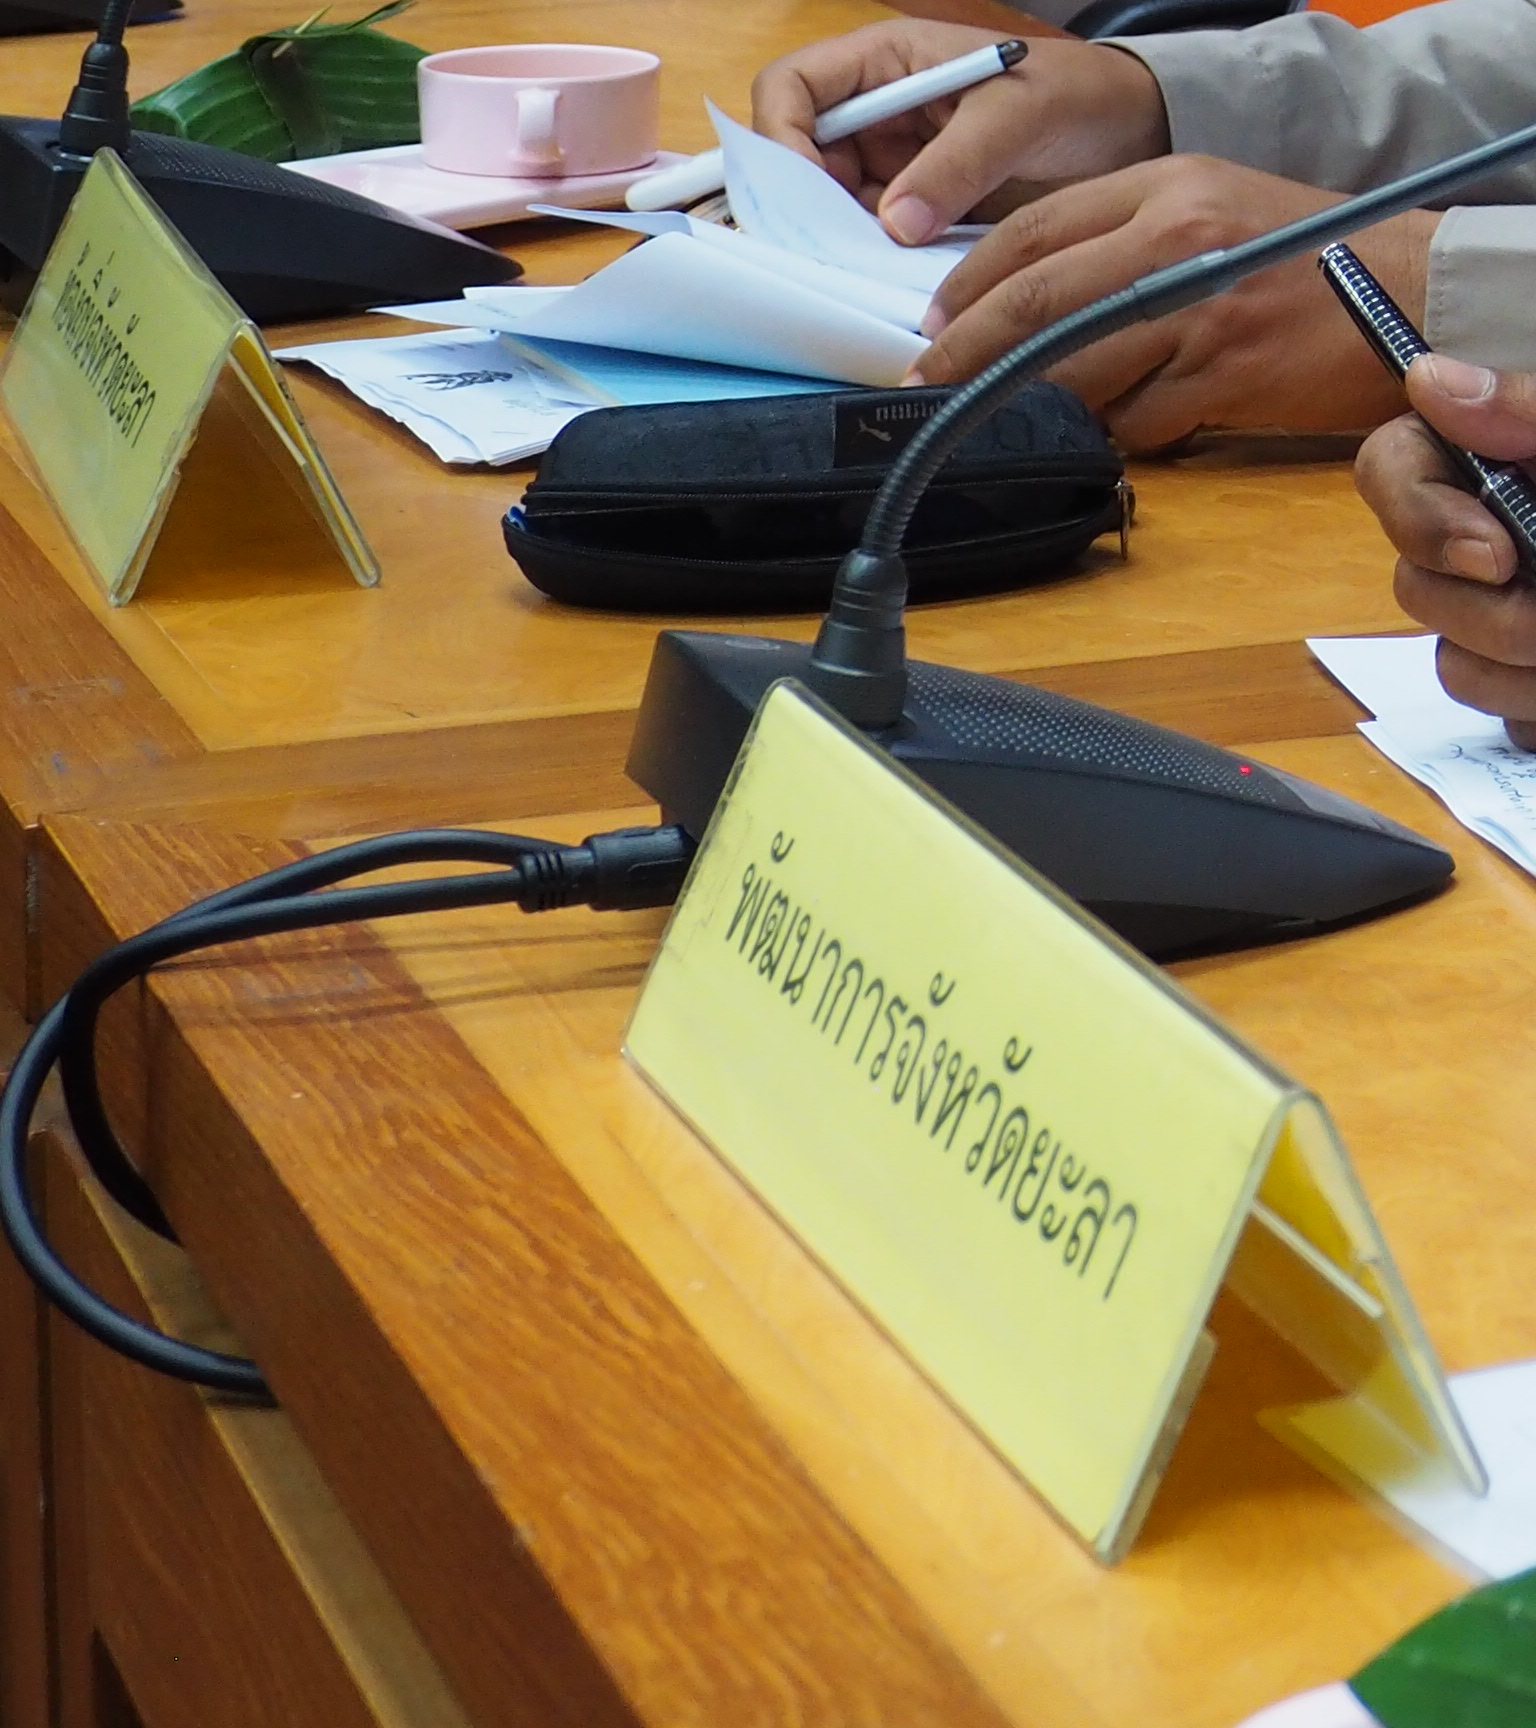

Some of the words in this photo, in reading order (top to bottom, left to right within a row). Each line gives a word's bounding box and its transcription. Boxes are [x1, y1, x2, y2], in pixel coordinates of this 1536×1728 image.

[724, 829, 1141, 1301] พัฒนาการจังหวัดยะลา
